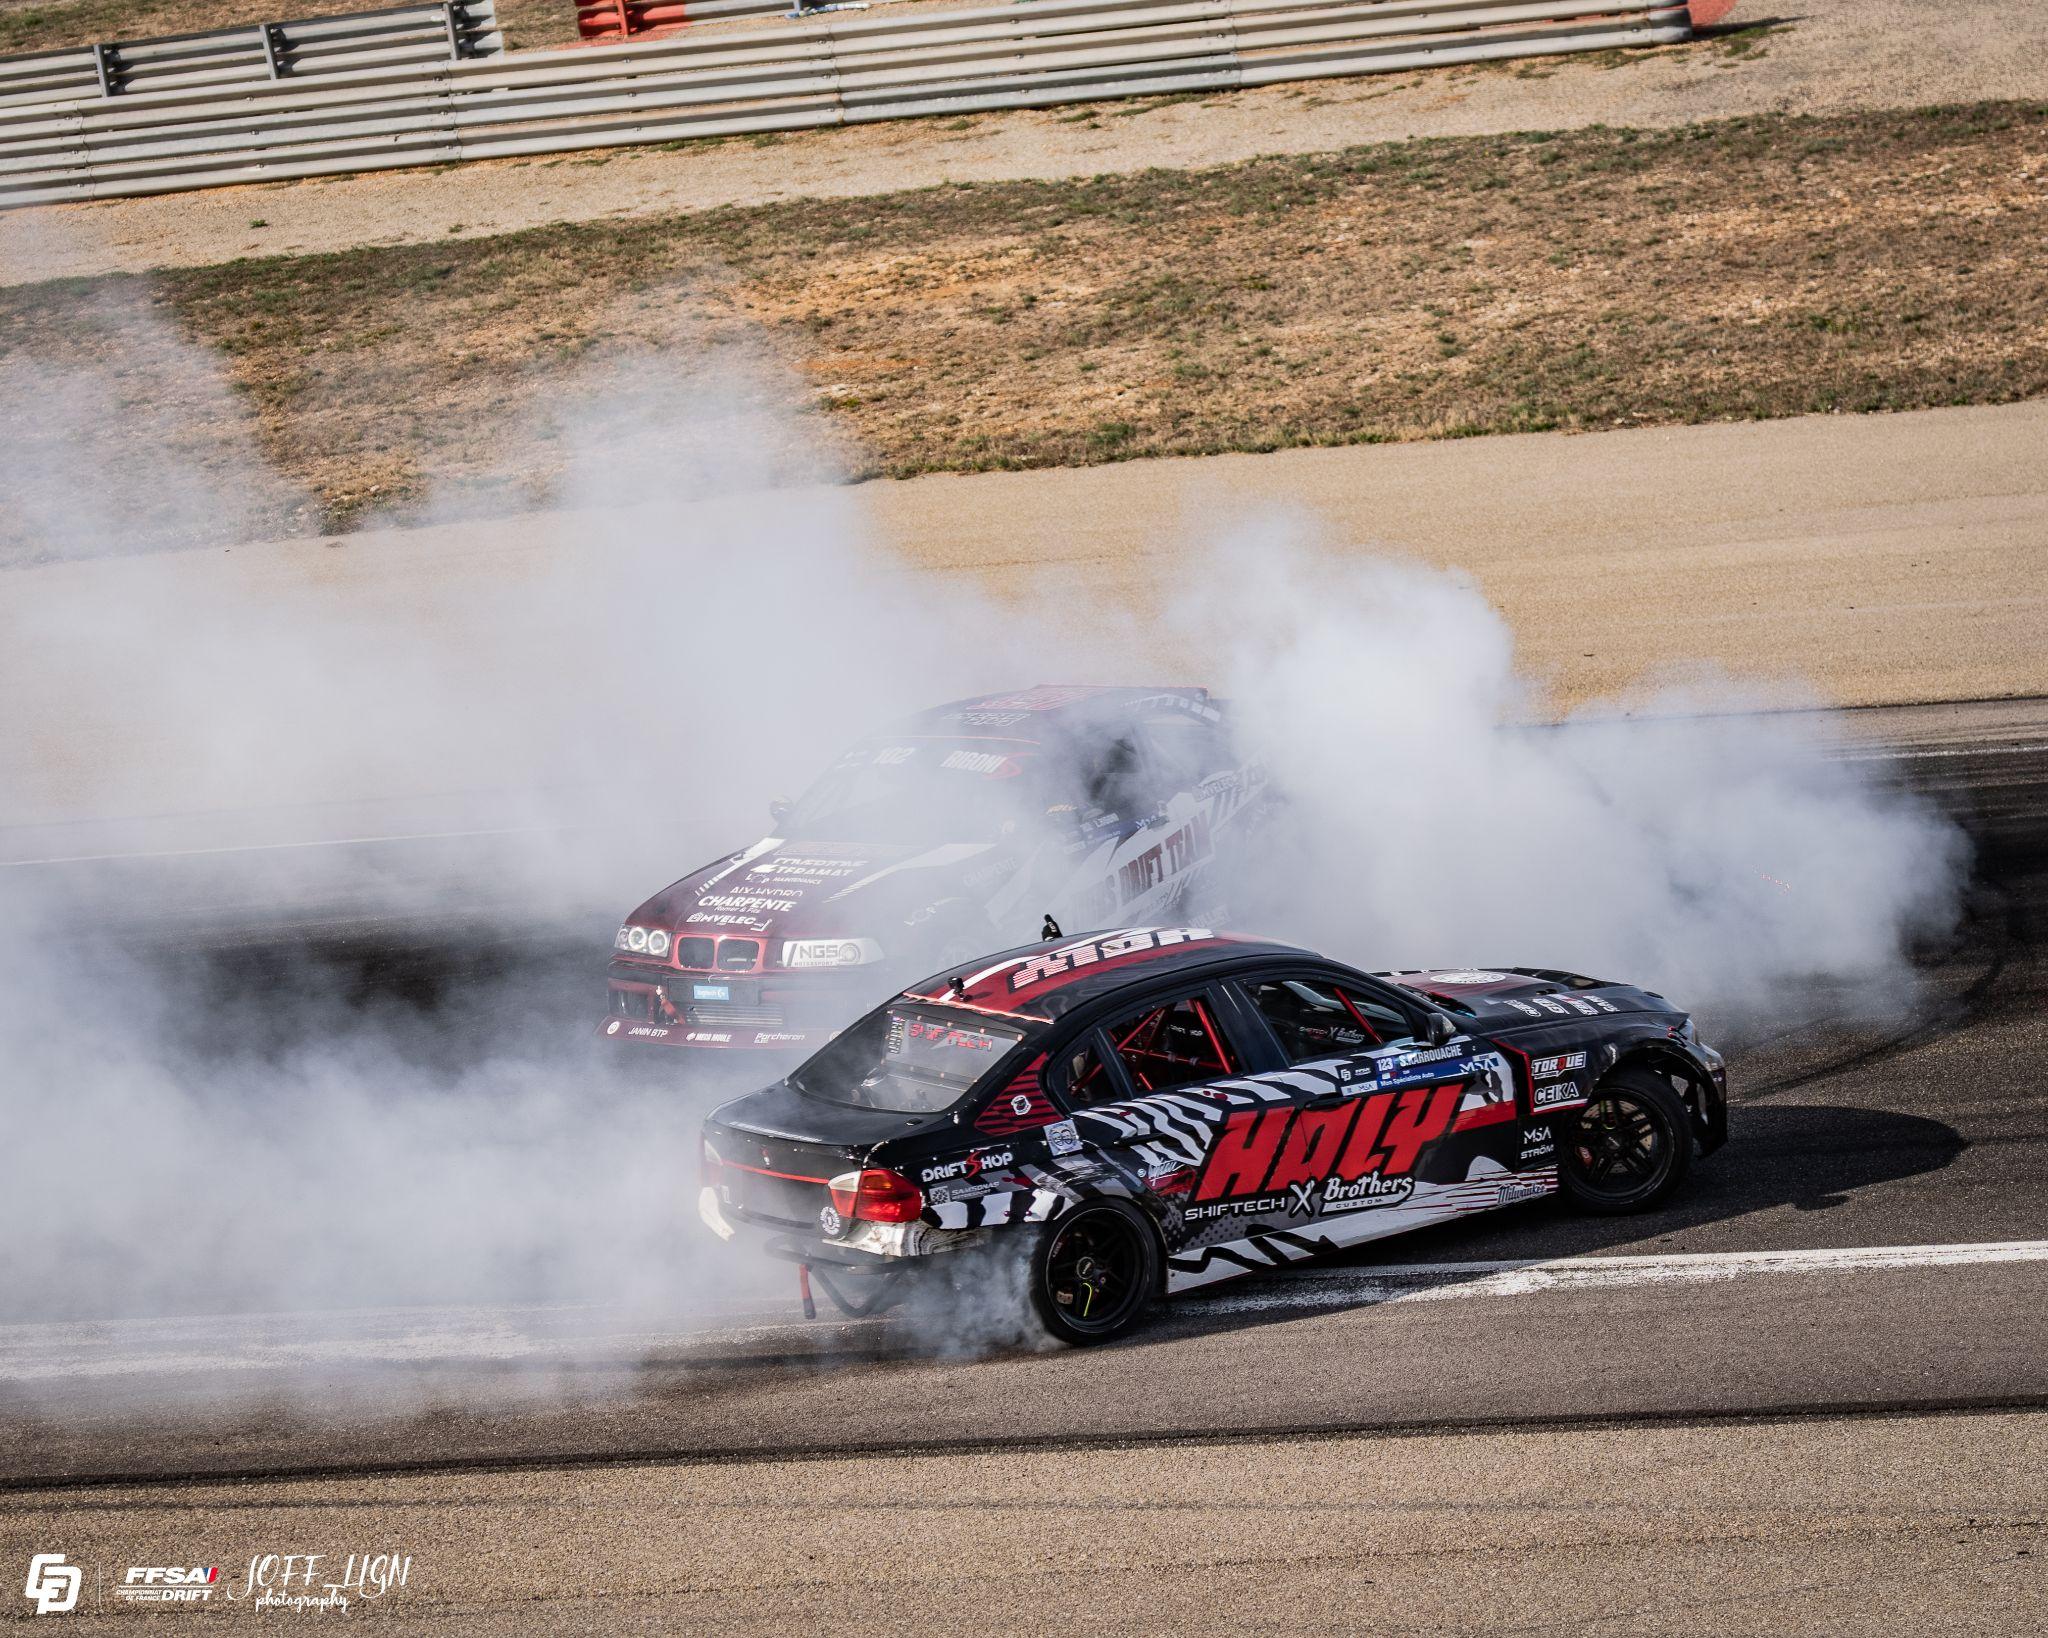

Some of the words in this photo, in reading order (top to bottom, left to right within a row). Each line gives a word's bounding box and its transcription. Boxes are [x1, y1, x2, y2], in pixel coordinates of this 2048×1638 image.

[1118, 843, 1163, 906] DRIFT
[698, 896, 798, 912] CHARPENTE
[799, 945, 838, 959] NGS
[651, 1028, 668, 1038] BTP
[1376, 1057, 1394, 1072] 123
[1534, 1054, 1584, 1073] TORQUE
[1534, 1082, 1579, 1105] CEIKA
[1195, 1085, 1464, 1202] HOLY
[1523, 1126, 1551, 1144] MSA
[1185, 1197, 1285, 1221] SHIFTECH
[1290, 1180, 1315, 1215] X
[1323, 1171, 1413, 1201] Brothers
[1336, 1198, 1384, 1209] CUSTOM
